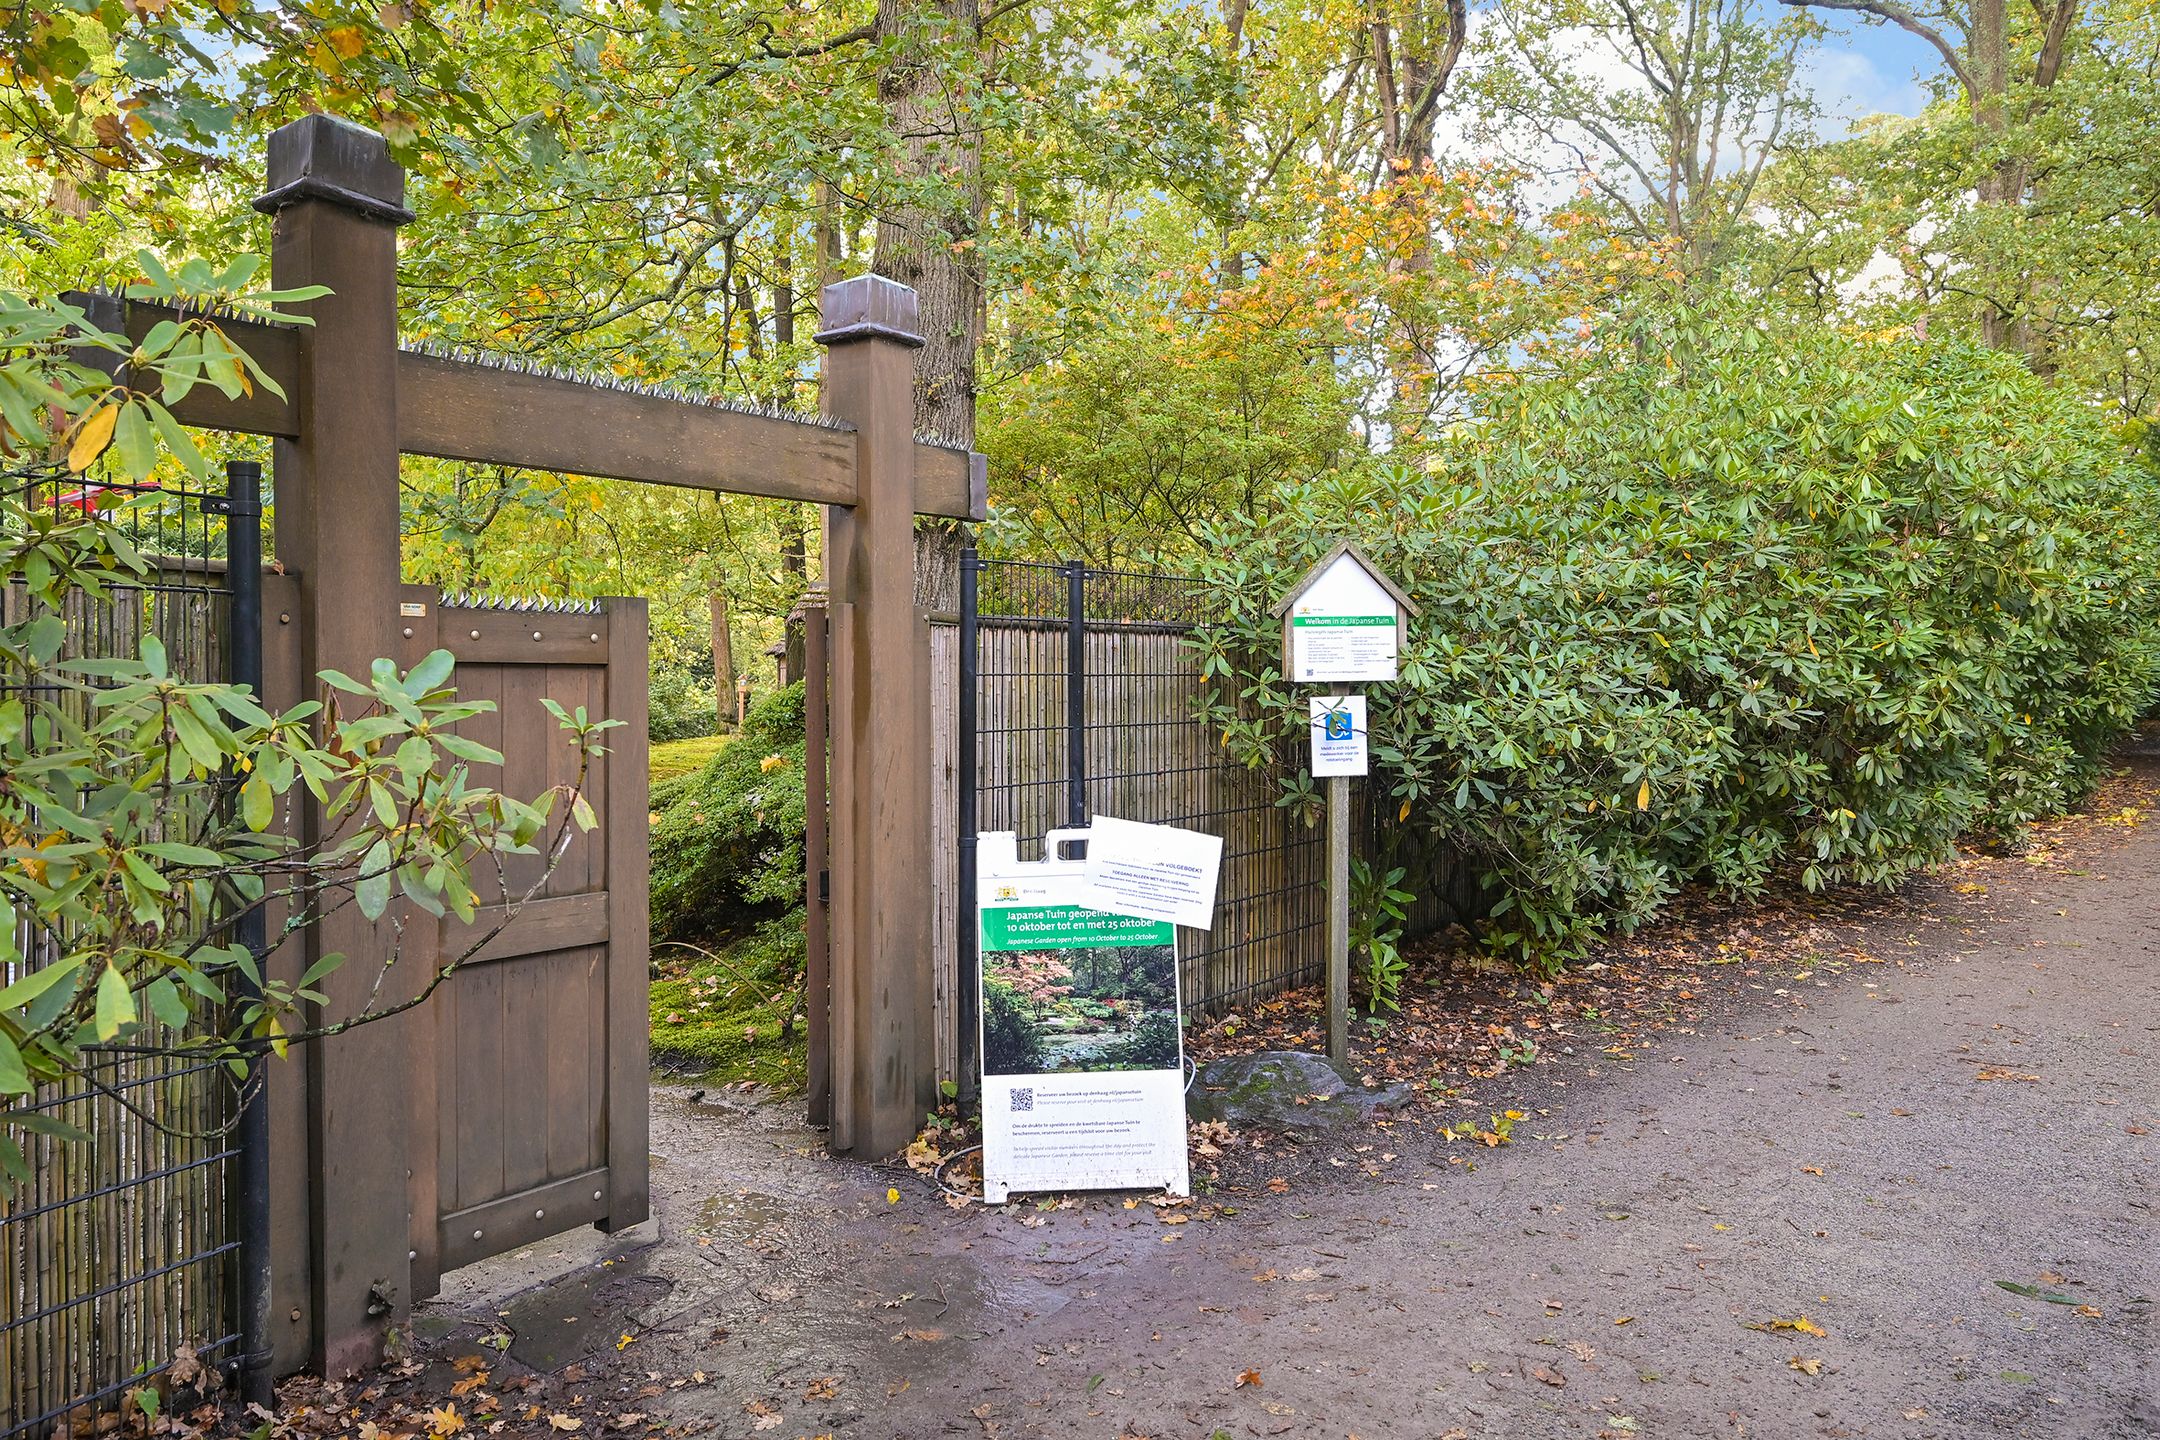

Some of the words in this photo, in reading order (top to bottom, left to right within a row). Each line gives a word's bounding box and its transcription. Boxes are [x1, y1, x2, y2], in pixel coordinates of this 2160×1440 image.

[1006, 911, 1044, 922] Japanse
[1045, 910, 1066, 919] Tuin
[1019, 922, 1055, 931] oktober
[1057, 921, 1071, 930] tot
[1087, 920, 1106, 928] met
[1107, 921, 1118, 930] 25
[1120, 919, 1156, 928] oktober
[1072, 936, 1087, 944] from
